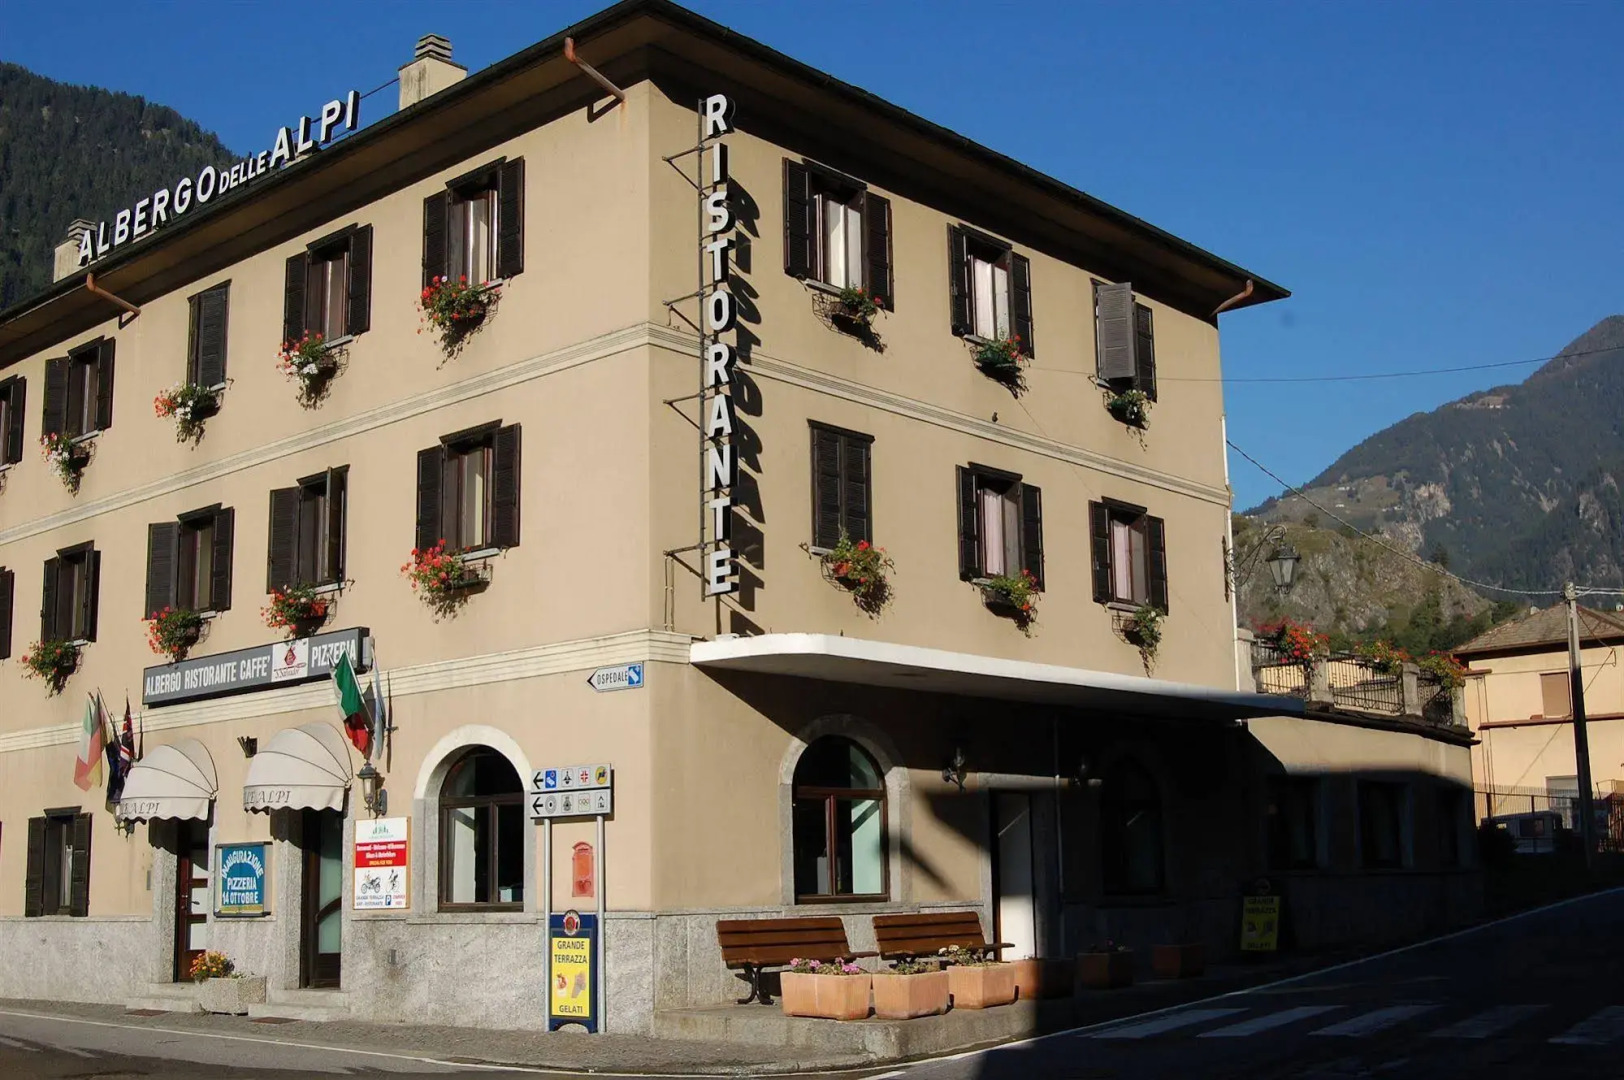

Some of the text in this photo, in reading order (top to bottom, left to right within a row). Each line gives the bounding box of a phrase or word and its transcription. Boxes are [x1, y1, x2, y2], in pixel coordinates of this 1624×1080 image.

[77, 90, 360, 266] ALBERGO DELLE ALPI
[705, 93, 737, 596] RISTORANTE
[145, 671, 182, 696] ALBERGO
[184, 661, 238, 690] RISTORANTE
[239, 655, 271, 681] CAFFE'
[596, 671, 628, 685] OSPEDALE
[258, 790, 292, 804] ALPI
[127, 802, 161, 815] ALPI
[221, 850, 264, 879] INAUGURAZIONE
[226, 876, 257, 890] PIZZERIA
[222, 891, 259, 905] 14 OTTOBRE
[557, 940, 585, 950] GRANDE
[554, 954, 588, 964] TERRAZZA
[559, 1005, 583, 1014] GELATI
